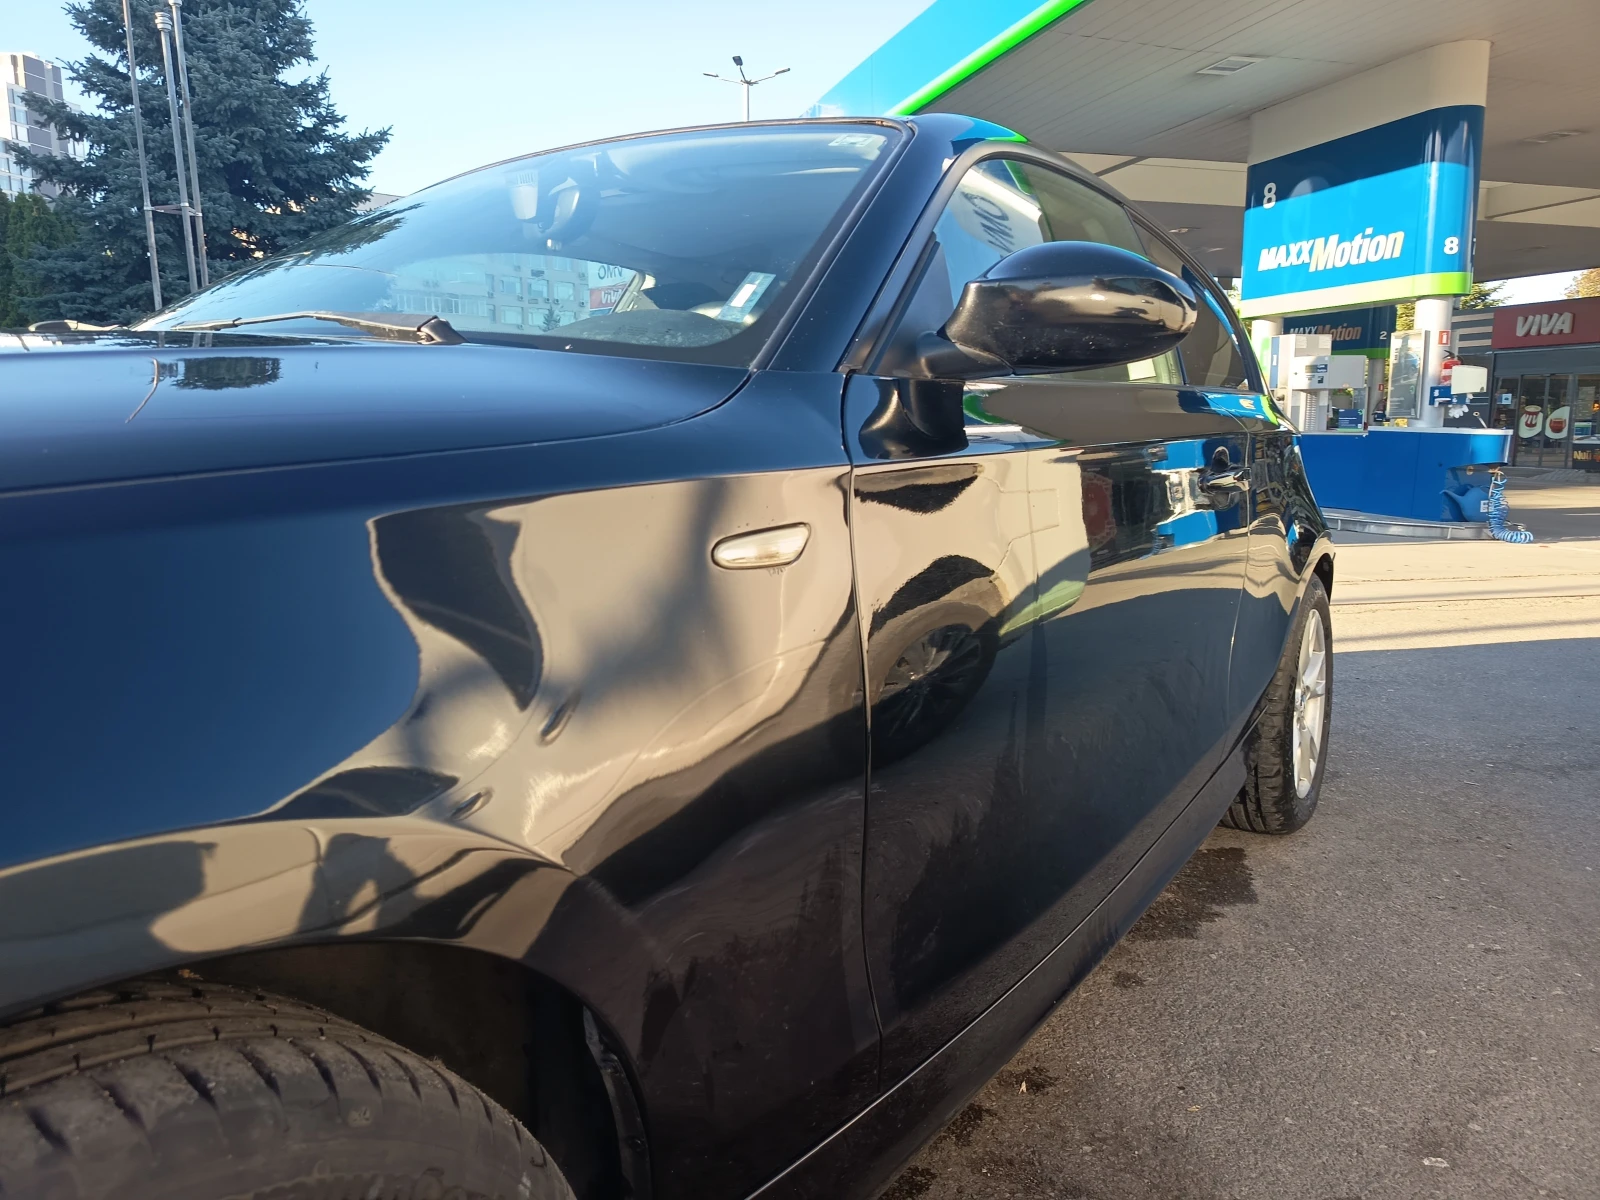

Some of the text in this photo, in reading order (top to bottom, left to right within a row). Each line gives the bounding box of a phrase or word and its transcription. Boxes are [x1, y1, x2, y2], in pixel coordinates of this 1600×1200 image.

[1262, 182, 1276, 209] 8
[1443, 236, 1459, 255] 8
[1379, 330, 1388, 340] 2
[1516, 311, 1575, 337] VIVA
